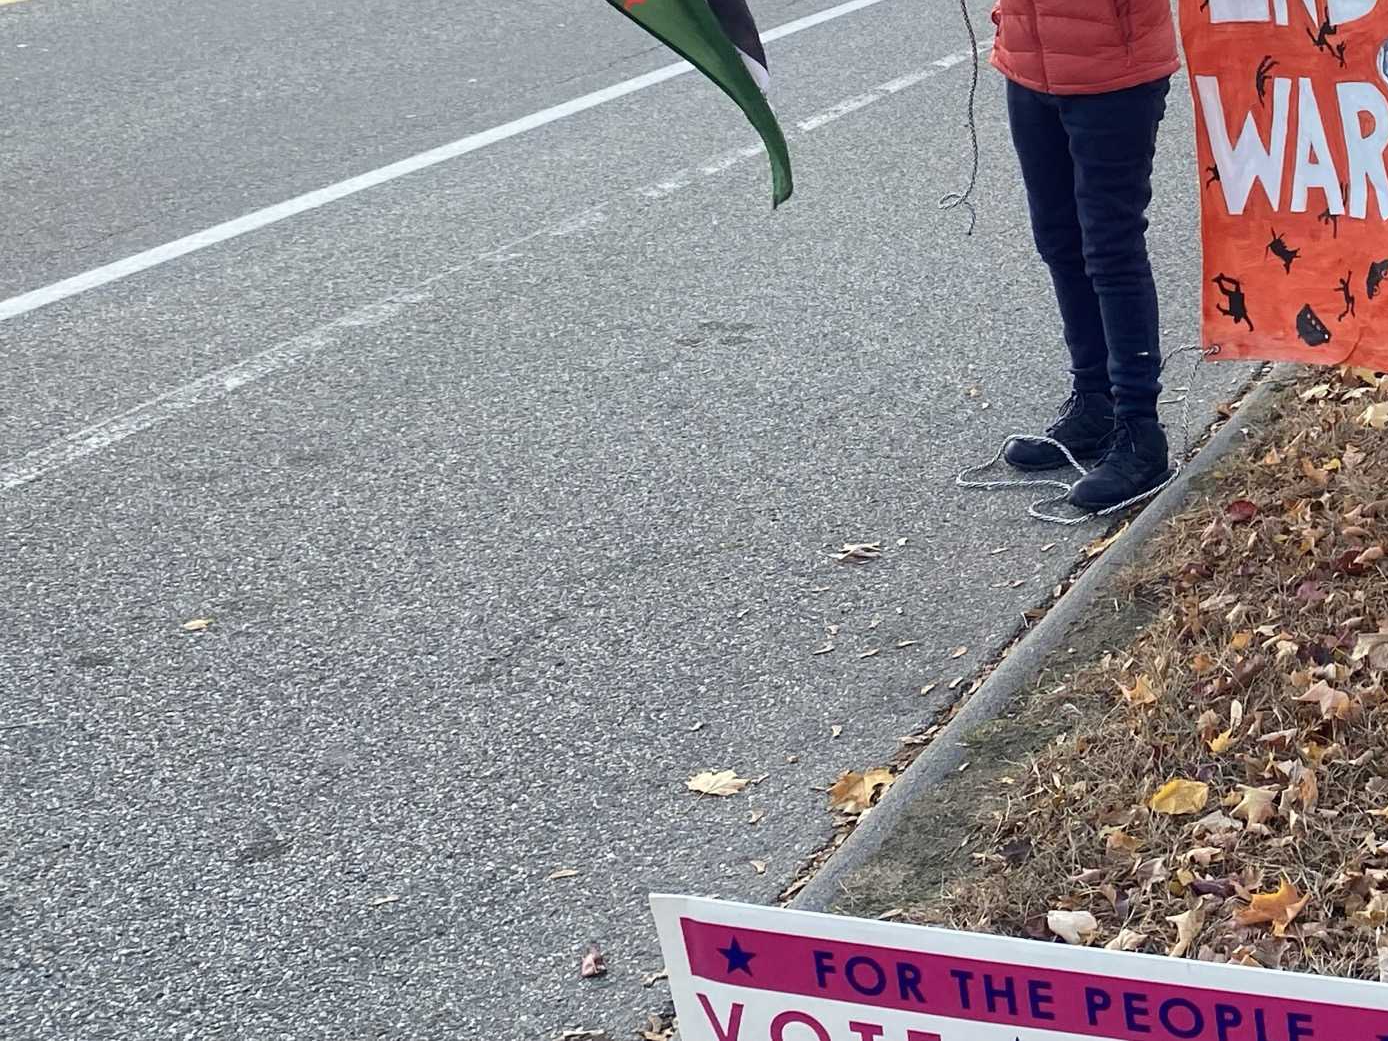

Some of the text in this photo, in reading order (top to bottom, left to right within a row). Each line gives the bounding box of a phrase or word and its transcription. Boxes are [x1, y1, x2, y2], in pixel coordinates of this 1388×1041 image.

[812, 950, 1316, 1041] FOR THE PEOPLE
